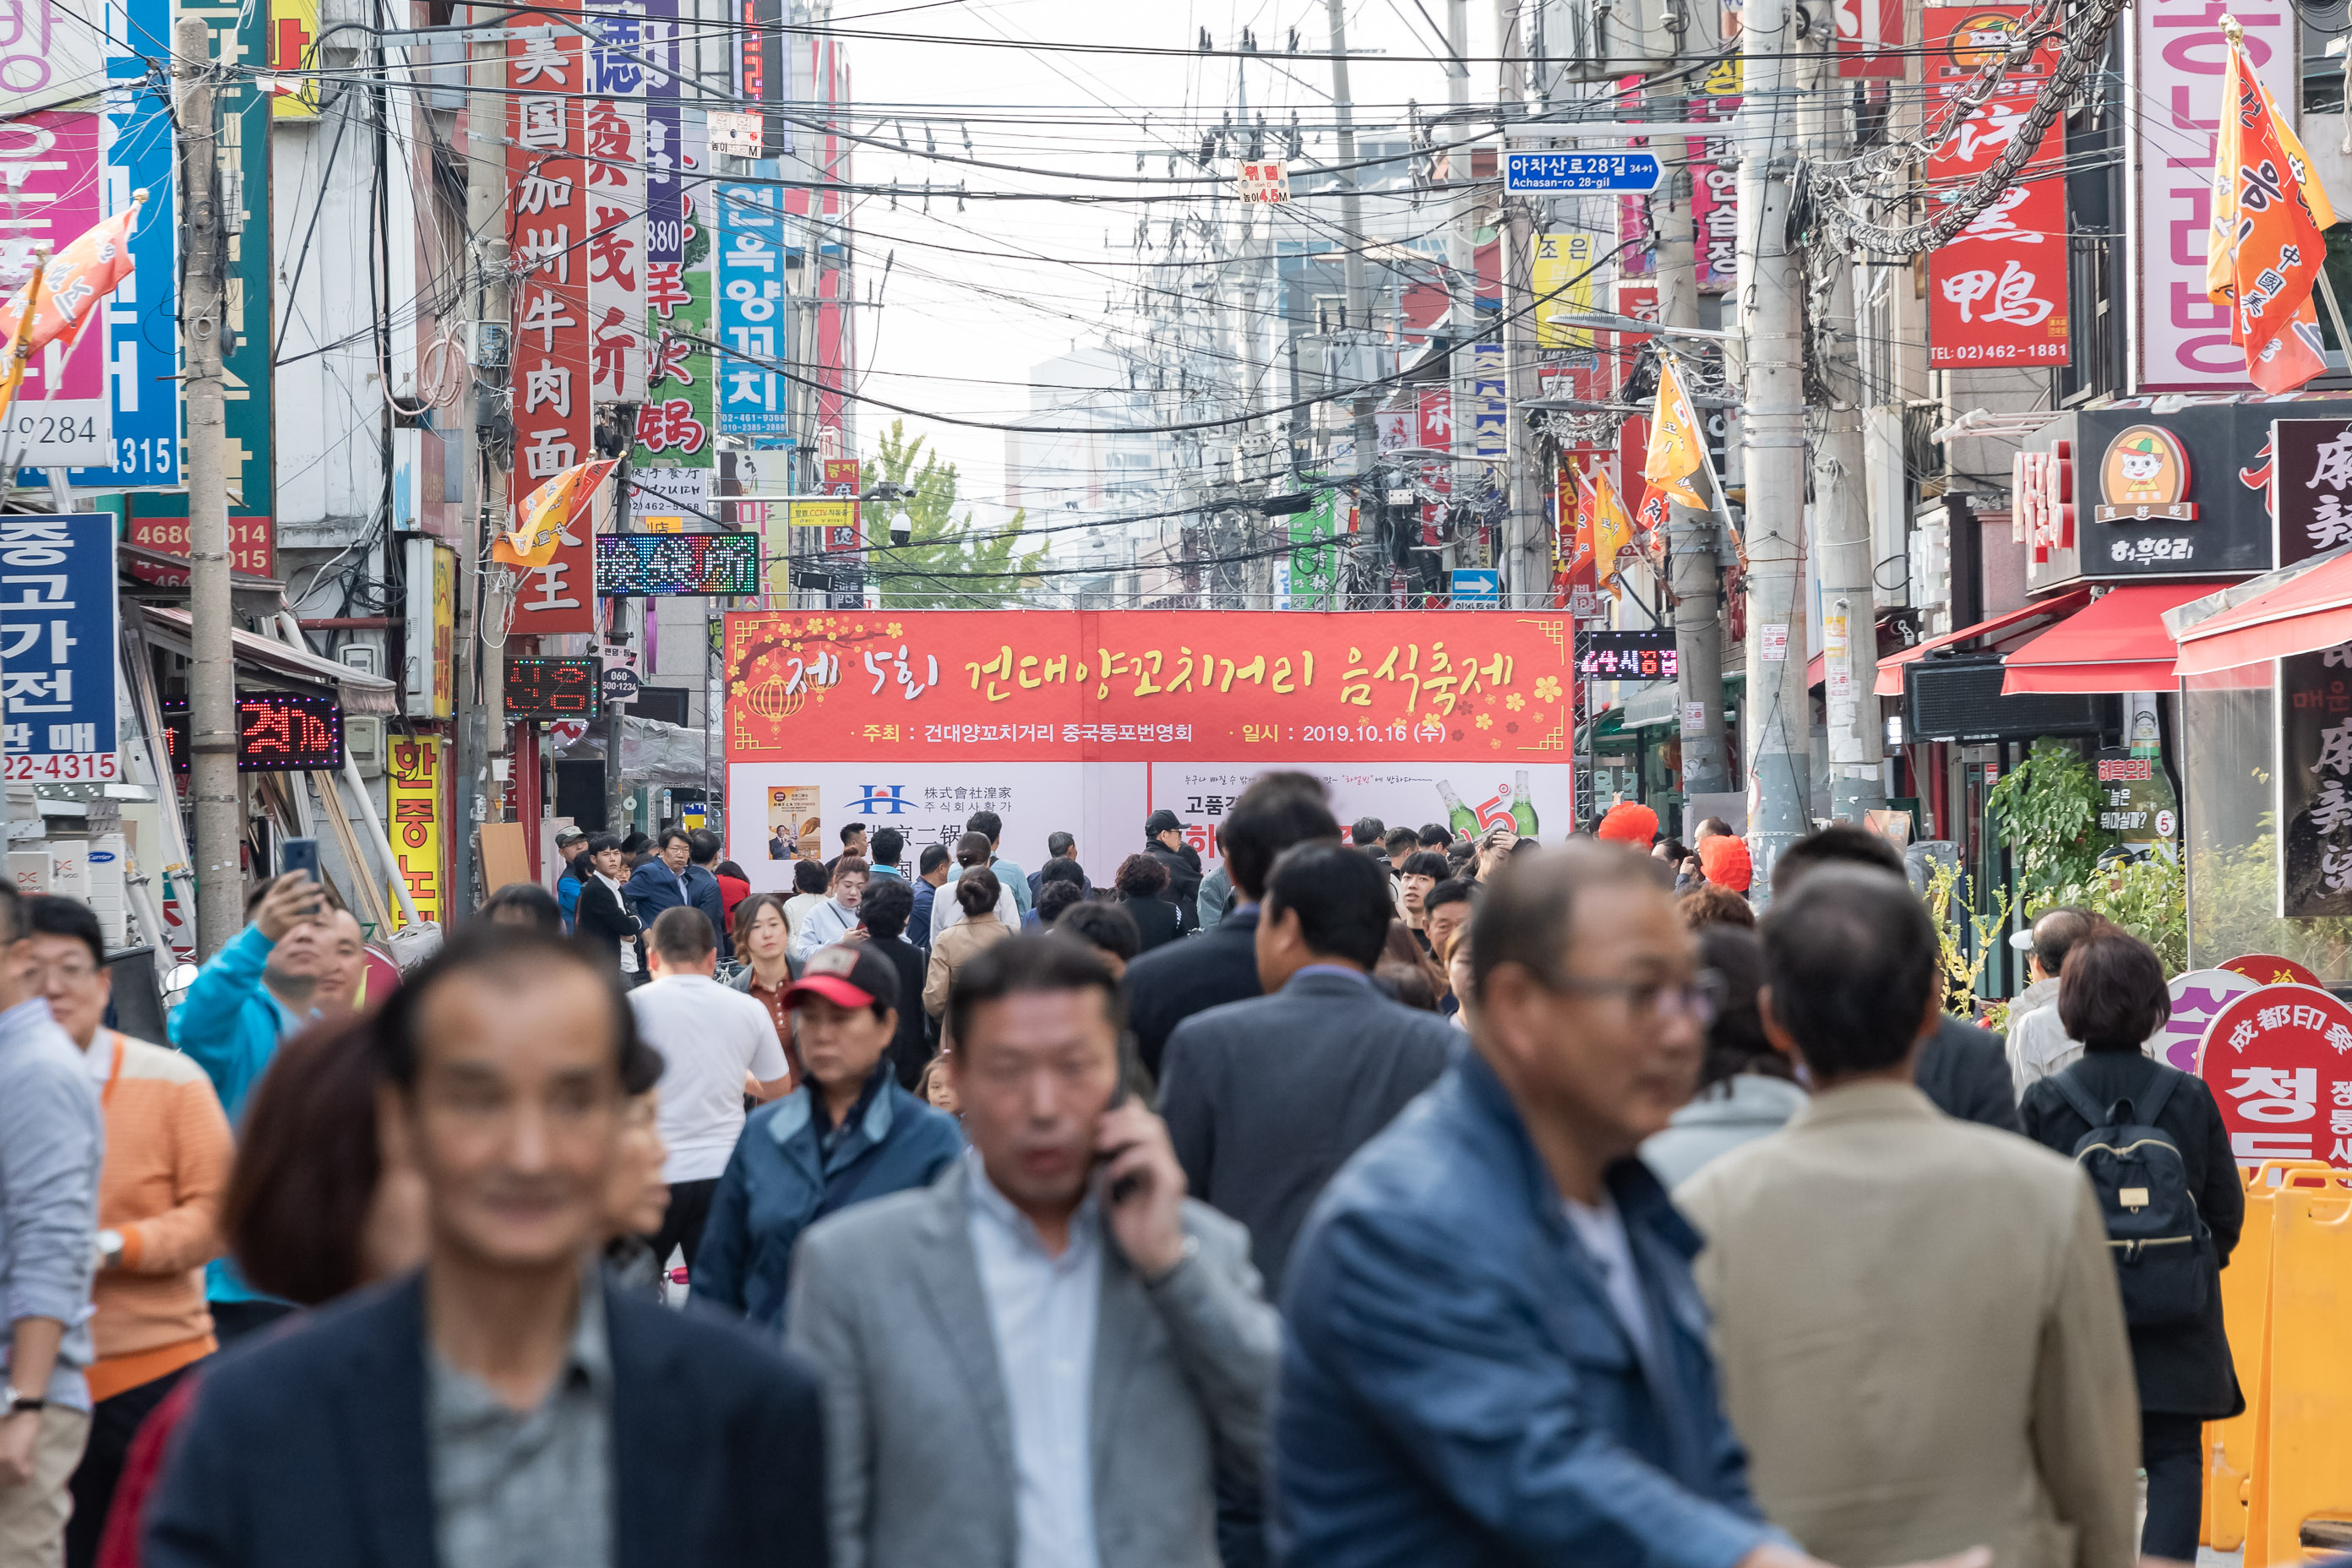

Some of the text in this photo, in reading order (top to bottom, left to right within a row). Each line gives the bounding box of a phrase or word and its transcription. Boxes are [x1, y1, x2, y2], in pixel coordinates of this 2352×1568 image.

[1511, 156, 1625, 176] 아차산로28길
[1511, 177, 1610, 188] Achasan-ro 28-gil
[514, 22, 581, 611] 美国加州牛肉面王
[2111, 537, 2194, 565] 허흑오리
[786, 641, 1513, 716] 제 5회 건대양꼬치거리 음식축제
[863, 723, 1446, 743] 주최 건대양꼬치거리 중국동포번영회 일시 2019.10.16 (수)
[2099, 759, 2152, 781] 허흑오리
